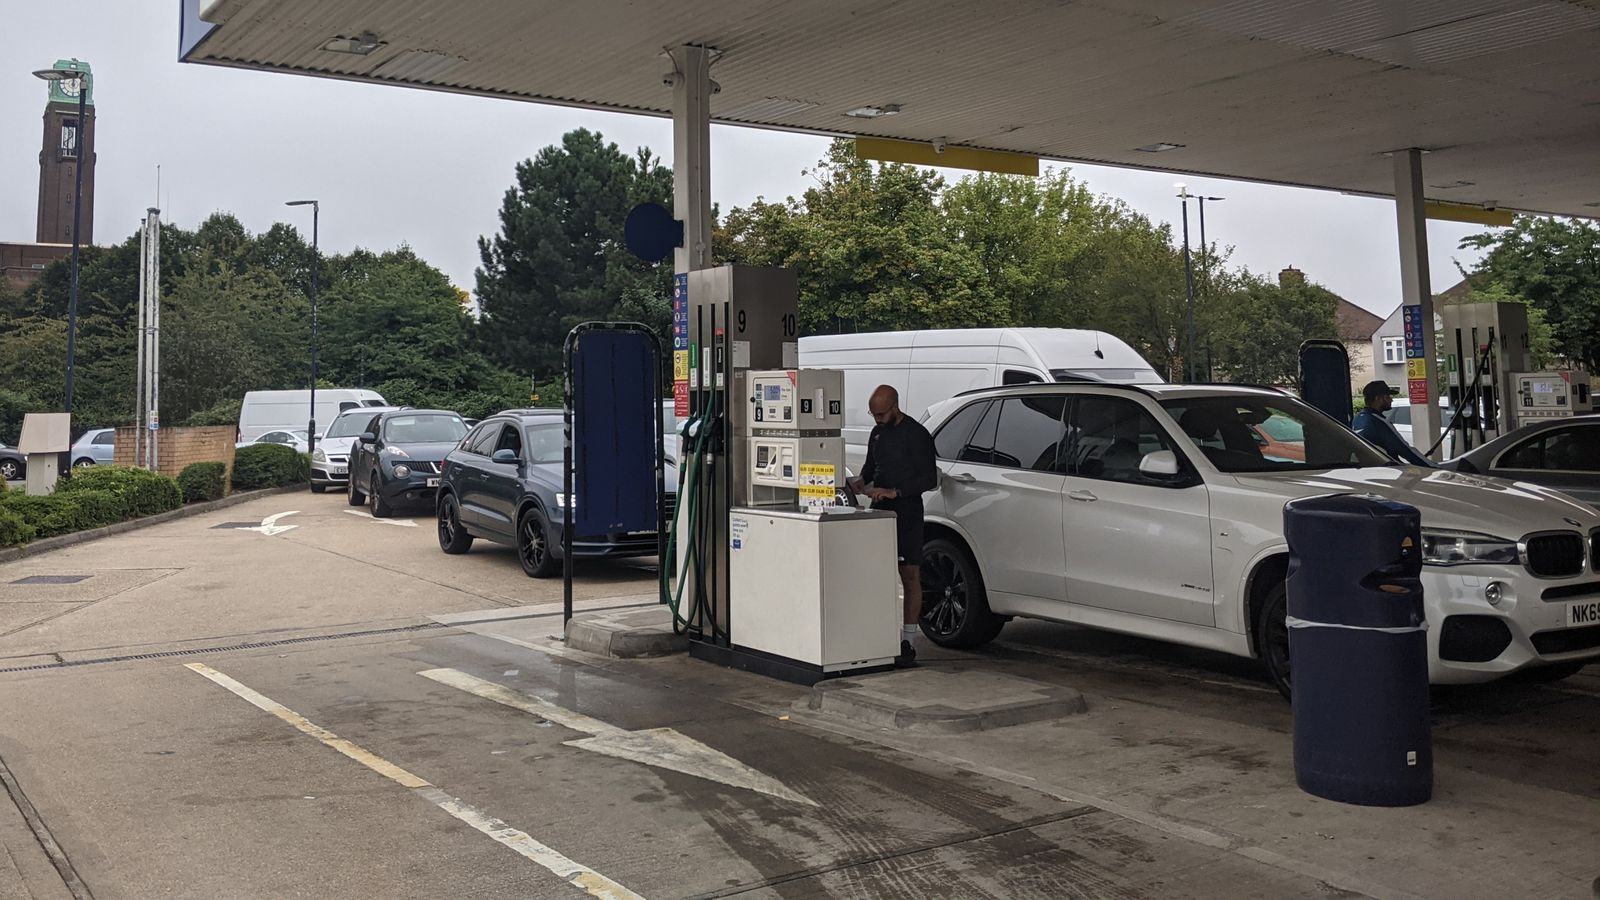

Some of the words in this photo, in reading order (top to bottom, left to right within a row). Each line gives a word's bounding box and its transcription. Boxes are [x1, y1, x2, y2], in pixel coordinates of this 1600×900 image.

[738, 309, 746, 333] 9
[781, 312, 796, 337] 10
[803, 400, 809, 412] 9
[830, 401, 839, 414] 10
[756, 408, 763, 421] 9
